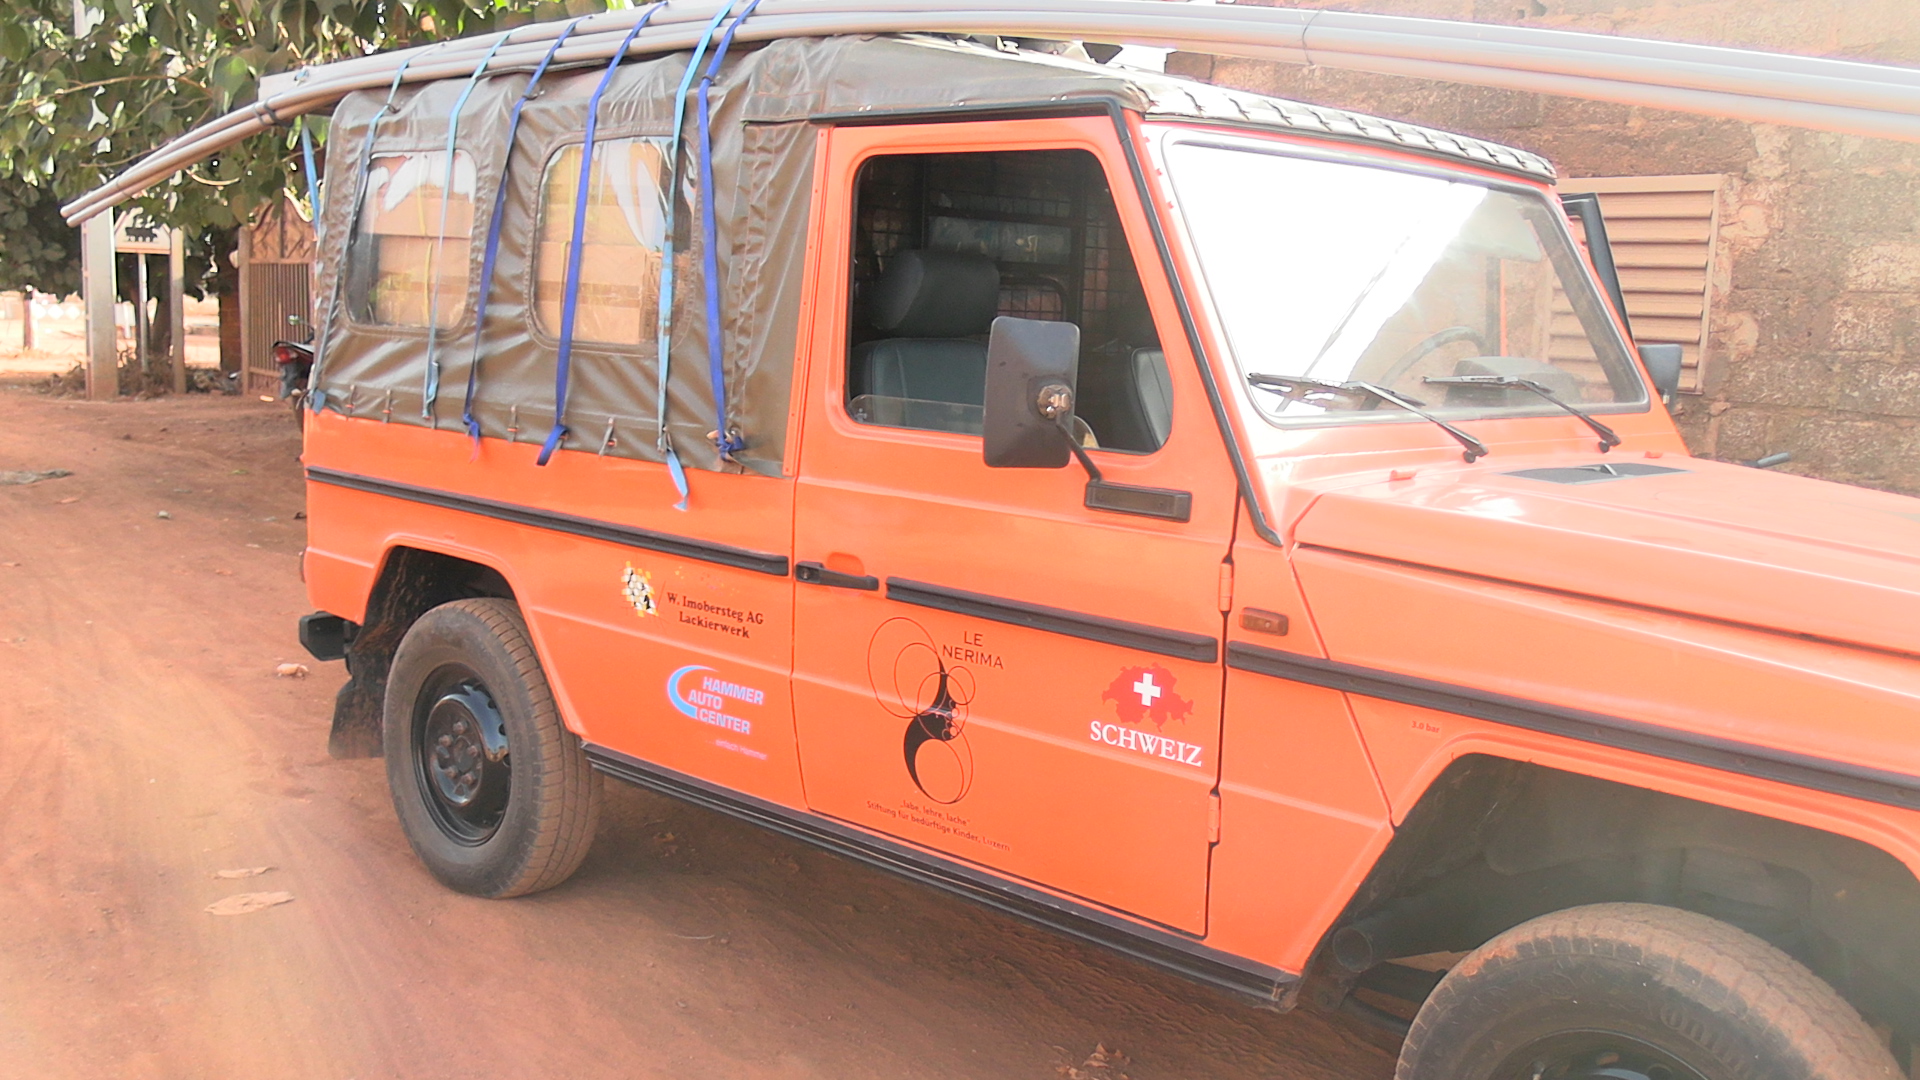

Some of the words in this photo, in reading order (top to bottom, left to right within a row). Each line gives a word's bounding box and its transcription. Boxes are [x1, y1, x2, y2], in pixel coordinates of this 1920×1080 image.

[667, 592, 680, 605] W.
[682, 596, 744, 622] Imobersteg
[747, 612, 764, 625] AG
[679, 611, 750, 638] Lackierwerk
[963, 630, 984, 648] LE
[942, 644, 1004, 670] NERIMA
[688, 689, 723, 710] AUTO
[702, 676, 764, 706] HAMMER
[699, 708, 751, 735] CENTER
[1090, 720, 1203, 768] SCHWEIZ
